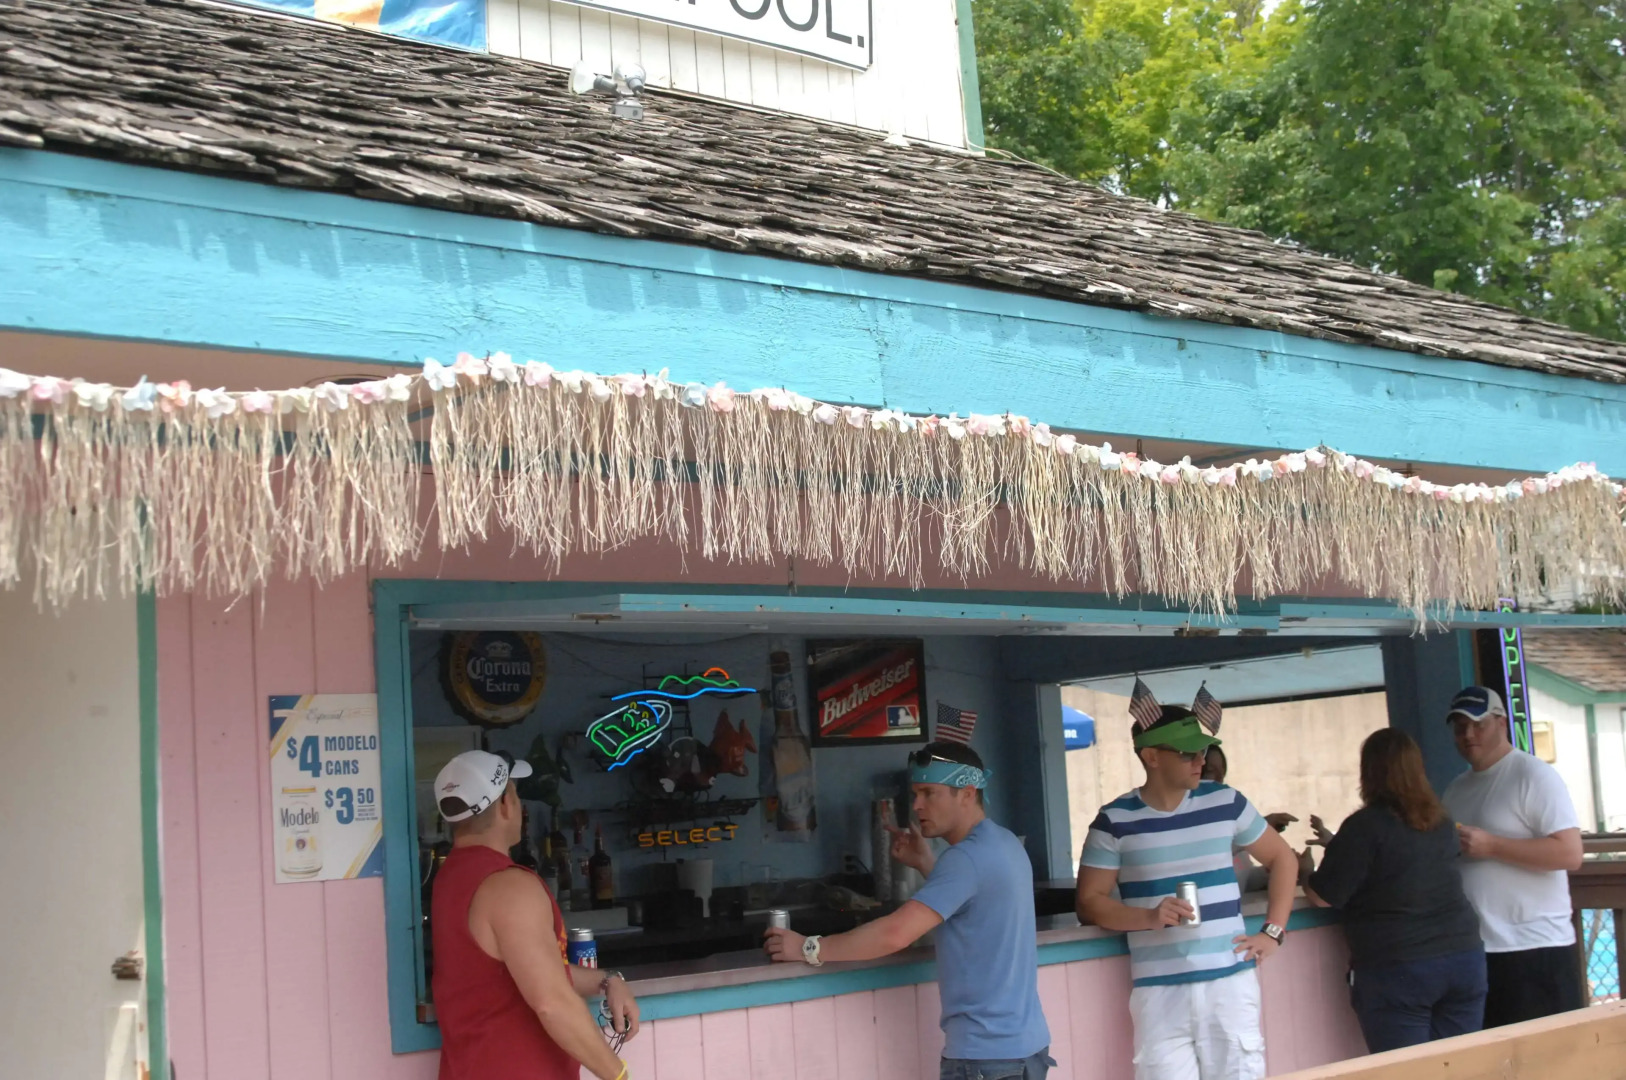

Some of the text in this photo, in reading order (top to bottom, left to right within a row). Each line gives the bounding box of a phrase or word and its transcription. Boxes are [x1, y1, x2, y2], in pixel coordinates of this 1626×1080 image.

[467, 657, 531, 682] Corona
[1501, 607, 1530, 752] OPEN
[486, 678, 520, 692] Extra
[821, 658, 915, 728] Budweiser
[286, 735, 376, 778] $4 MODELO
[325, 759, 359, 775] CANS
[280, 806, 319, 828] Modelo
[638, 824, 739, 847] SELECT
